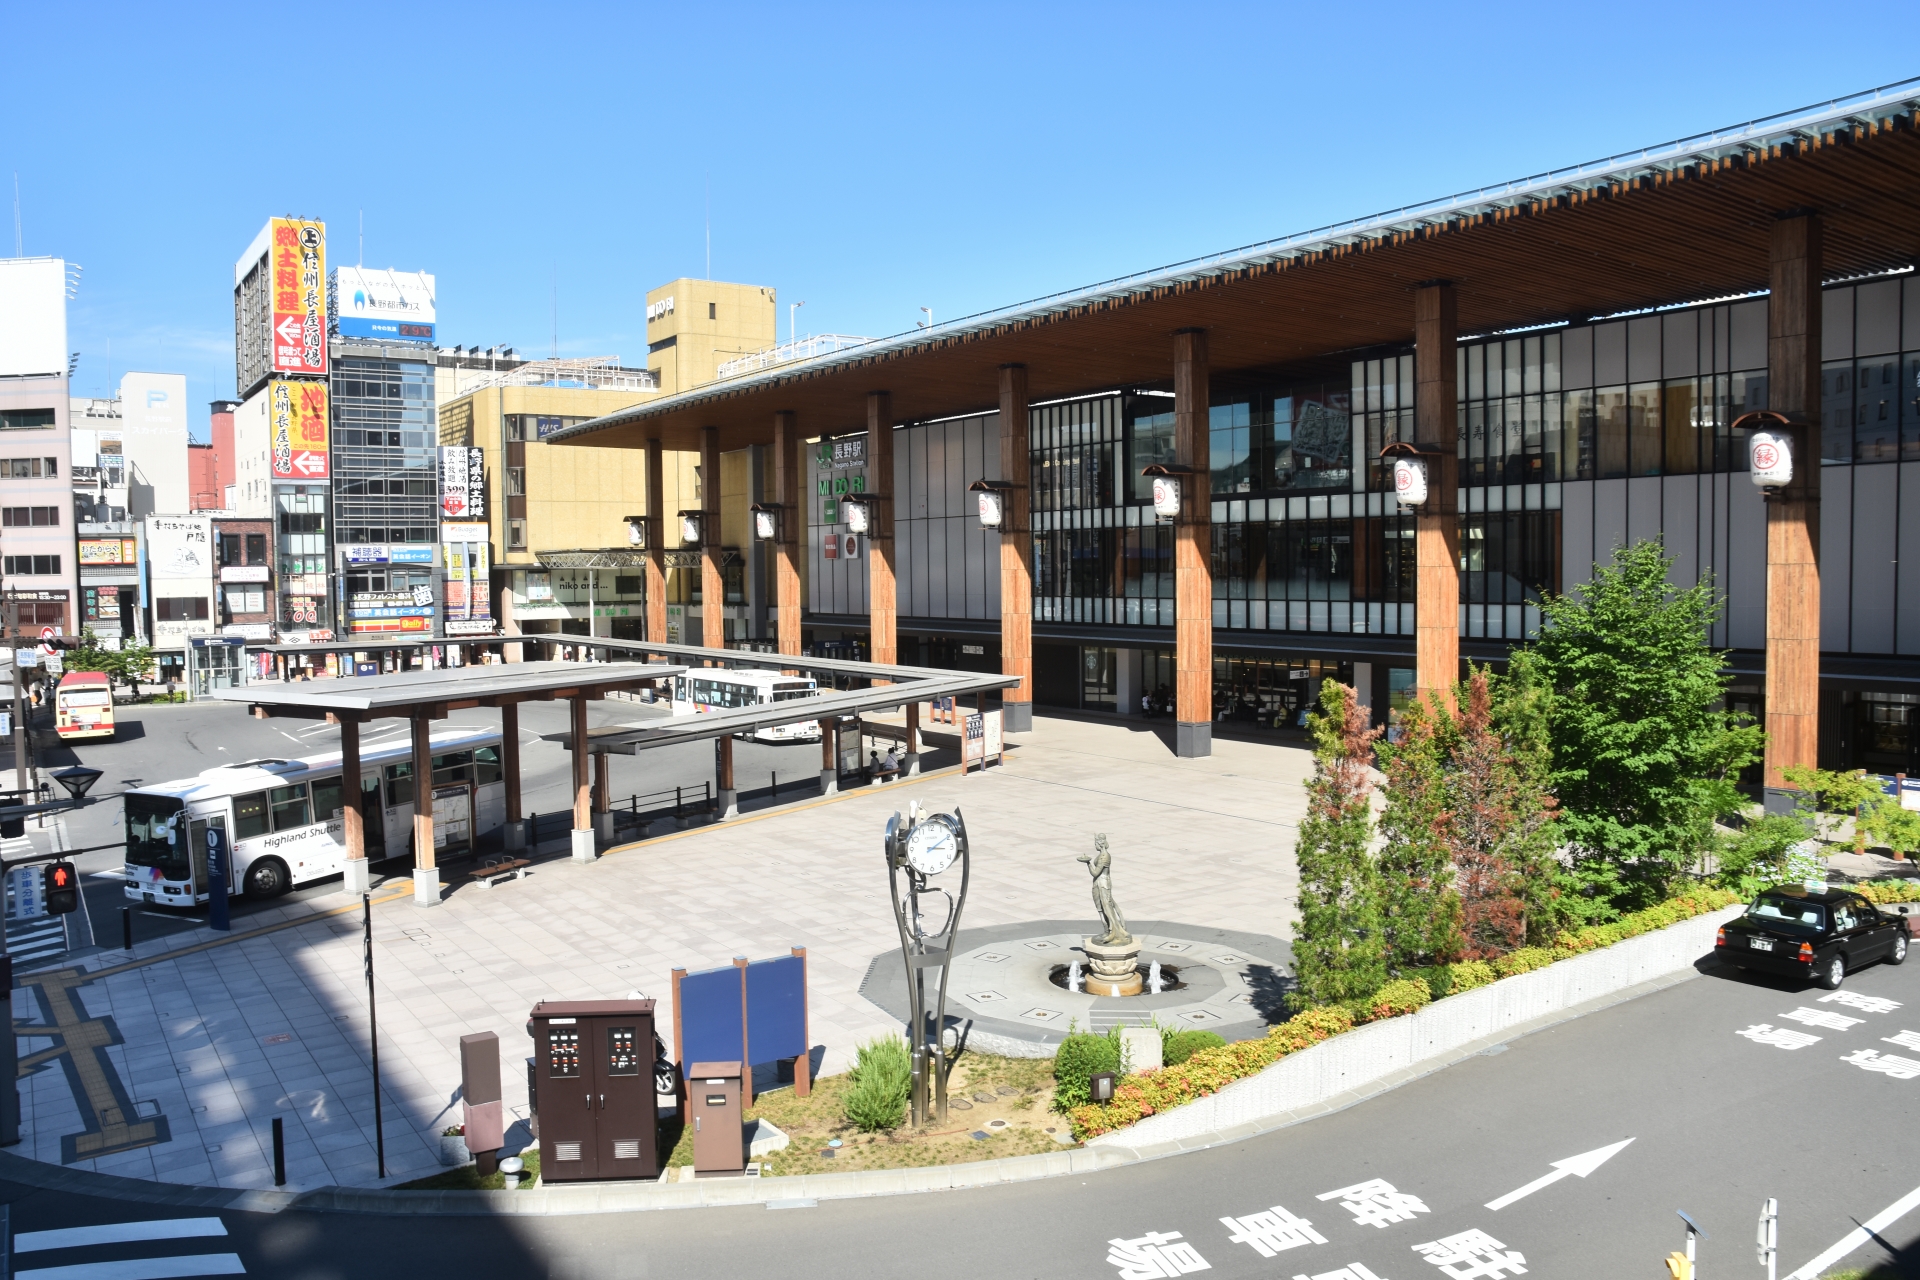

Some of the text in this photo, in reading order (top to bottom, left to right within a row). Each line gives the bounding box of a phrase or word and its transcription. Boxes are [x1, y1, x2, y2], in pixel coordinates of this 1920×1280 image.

[276, 226, 299, 311] 郷土料理
[303, 252, 321, 366] 信州長屋酒場
[369, 299, 420, 311] 長野都市ガス
[279, 356, 302, 367] 直進
[147, 389, 168, 408] P
[300, 386, 325, 442] 地酒
[275, 385, 290, 472] 信州長屋酒場
[835, 441, 862, 459] 長野駅
[1756, 448, 1774, 465] 縁
[447, 448, 456, 483] 飲み放題
[834, 459, 865, 469] Nagano Station
[469, 448, 485, 516] 長野県の郷土料理
[154, 520, 202, 530] 手打ちそば処
[457, 526, 478, 534] Budget
[186, 532, 206, 542] 戸隠
[81, 545, 120, 553] おたからや
[352, 547, 382, 557] 補聴器
[560, 582, 578, 590] niko
[412, 585, 433, 607] 歯
[374, 608, 422, 617] 英会話イーオン
[264, 822, 342, 848] Highland Shuttle
[21, 871, 34, 915] 歩車分離式
